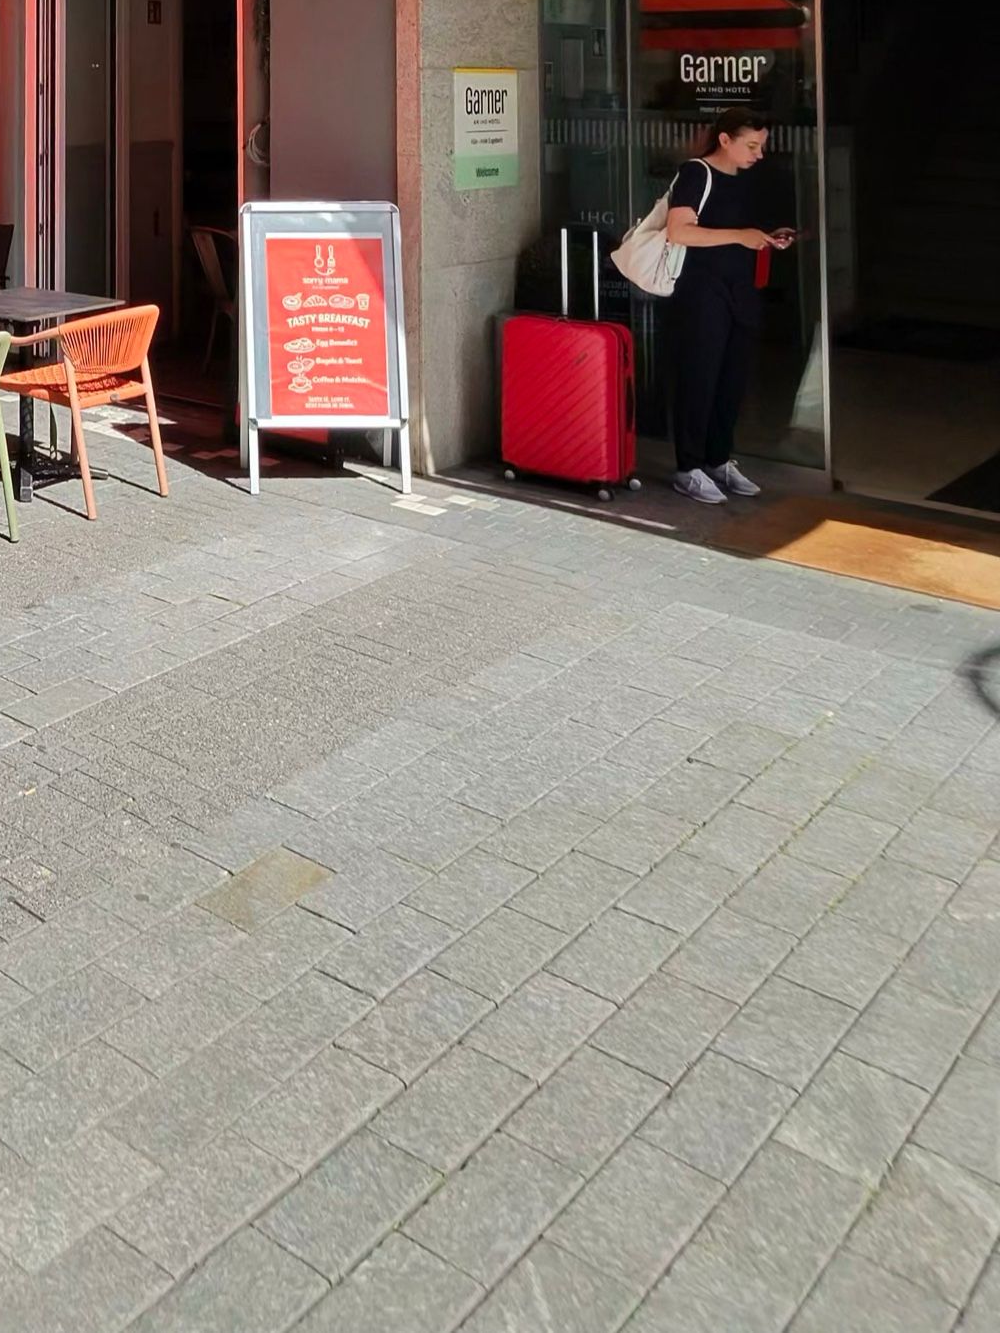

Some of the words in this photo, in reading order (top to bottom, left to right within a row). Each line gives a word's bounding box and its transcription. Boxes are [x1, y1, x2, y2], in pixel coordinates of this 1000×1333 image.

[680, 54, 766, 83] Garner
[465, 87, 507, 115] Garner
[302, 277, 323, 285] sorry
[286, 314, 317, 328] TASTY
[318, 313, 371, 328] BREAKFAST
[316, 339, 328, 347] Egg
